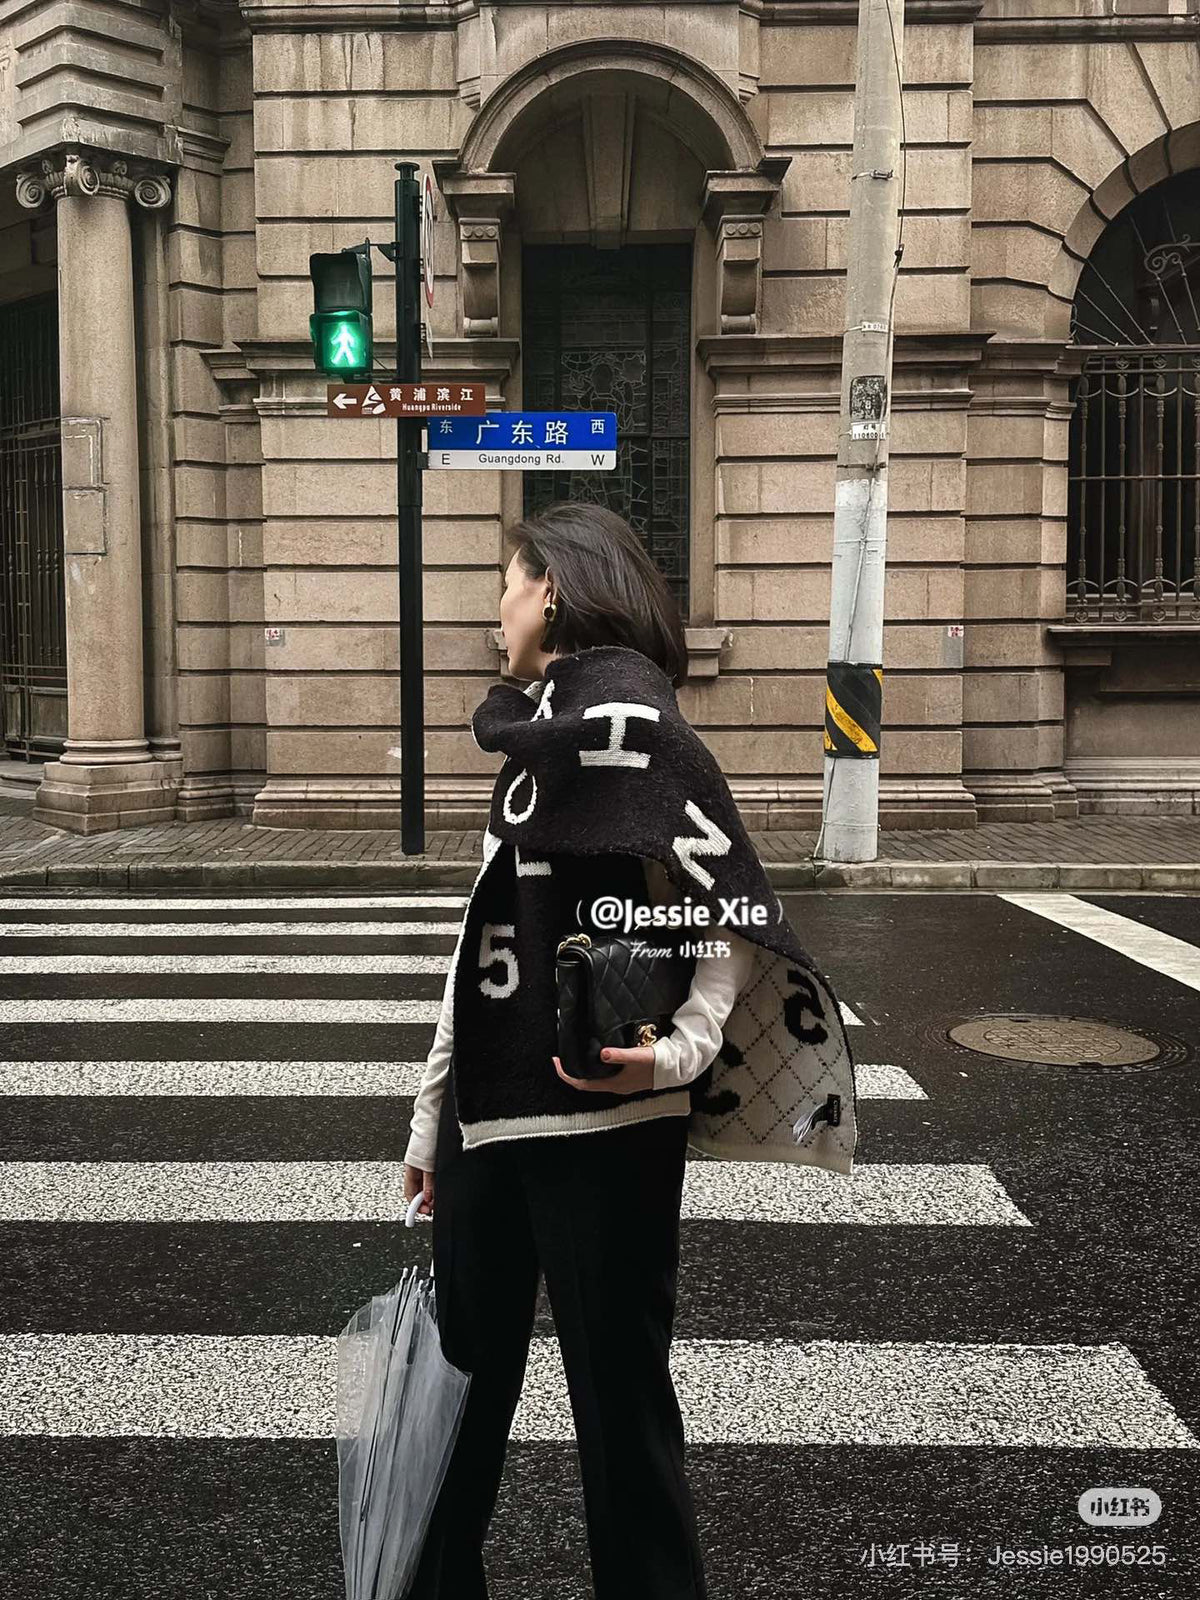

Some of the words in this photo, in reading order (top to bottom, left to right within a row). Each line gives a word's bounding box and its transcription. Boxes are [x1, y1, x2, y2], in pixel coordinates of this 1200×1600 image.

[389, 387, 474, 402] 黄浦滨江
[431, 403, 461, 411] Riverside
[439, 419, 453, 434] 东
[475, 420, 569, 445] 广东路
[591, 419, 605, 434] 西
[441, 453, 451, 465] E
[478, 453, 541, 466] Guangdong
[546, 453, 565, 464] Rd.
[591, 454, 605, 466] W
[478, 923, 520, 1000] 5
